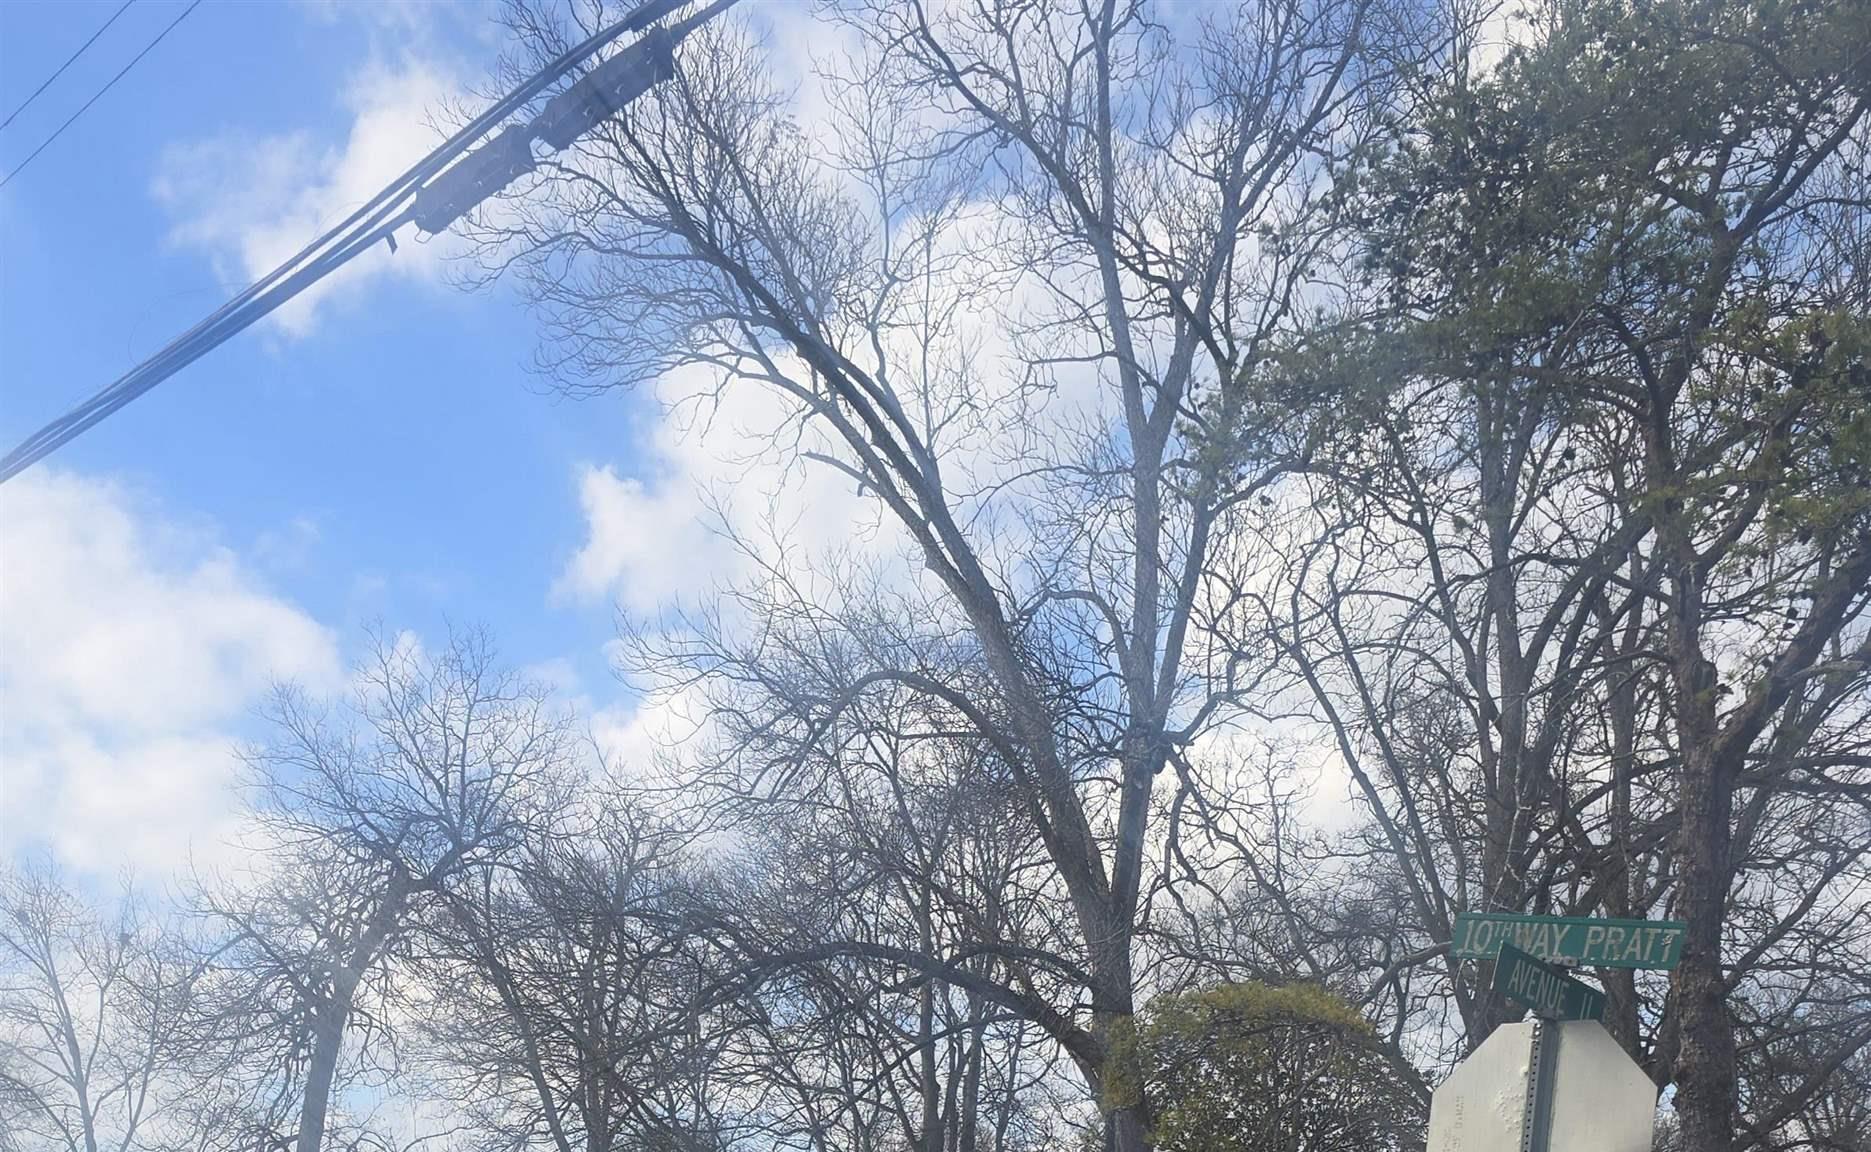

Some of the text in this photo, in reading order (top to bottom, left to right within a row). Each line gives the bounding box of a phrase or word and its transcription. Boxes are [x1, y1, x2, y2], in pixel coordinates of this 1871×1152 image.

[1464, 919, 1681, 962] 10TH WAY PRATT
[1508, 959, 1569, 1017] AVENUE
